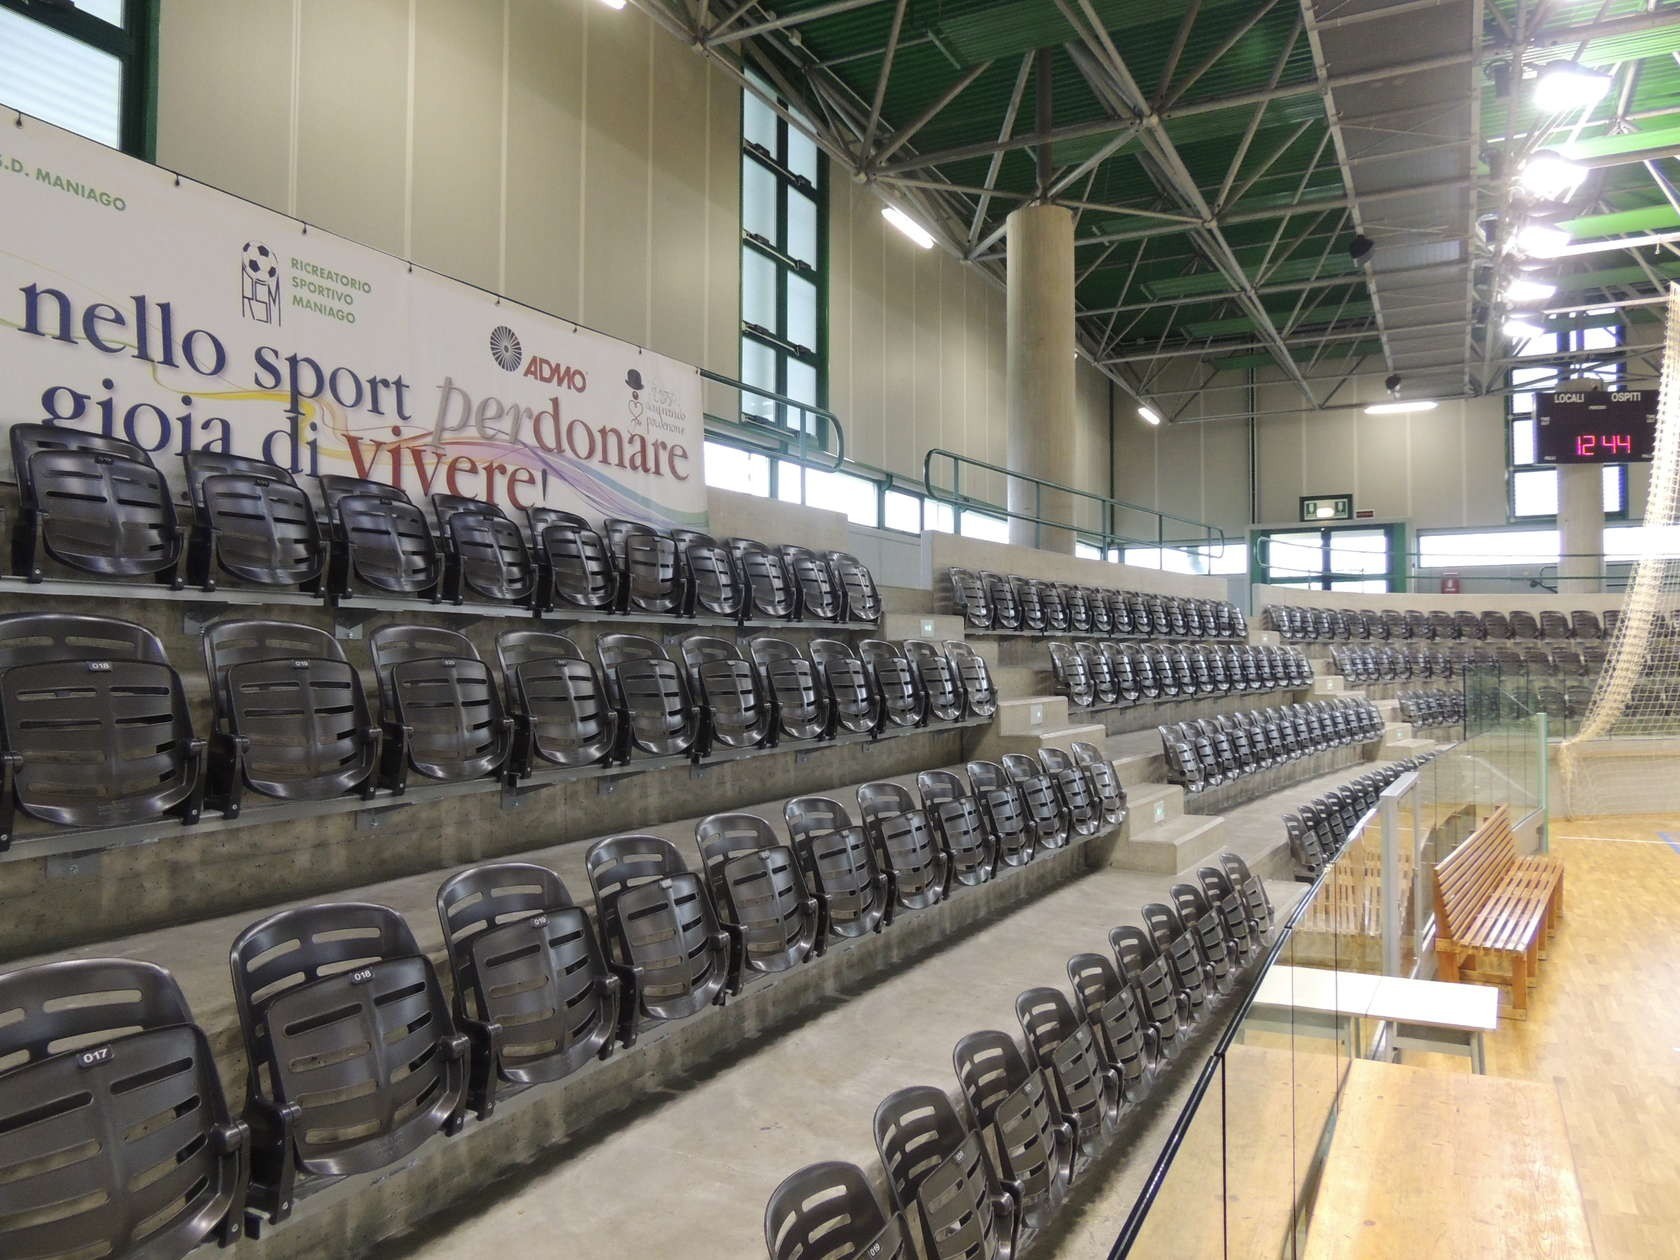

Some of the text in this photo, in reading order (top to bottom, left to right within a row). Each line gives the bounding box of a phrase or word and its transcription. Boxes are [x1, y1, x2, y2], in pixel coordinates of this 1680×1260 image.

[36, 167, 127, 211] MANIAGO
[291, 257, 372, 294] RICREATORIO
[291, 276, 354, 306] SPORTIVO
[292, 294, 356, 324] MANIAGO
[18, 282, 227, 377] nello
[254, 345, 412, 422] sport
[424, 376, 690, 482] perdonare
[523, 355, 587, 393] ADMO
[1554, 392, 1641, 404] LOCALI OSPITI
[41, 377, 232, 457] gioia
[262, 414, 321, 477] di
[353, 970, 372, 982] 018
[83, 1048, 109, 1064] 017
[870, 1243, 882, 1257] 019
